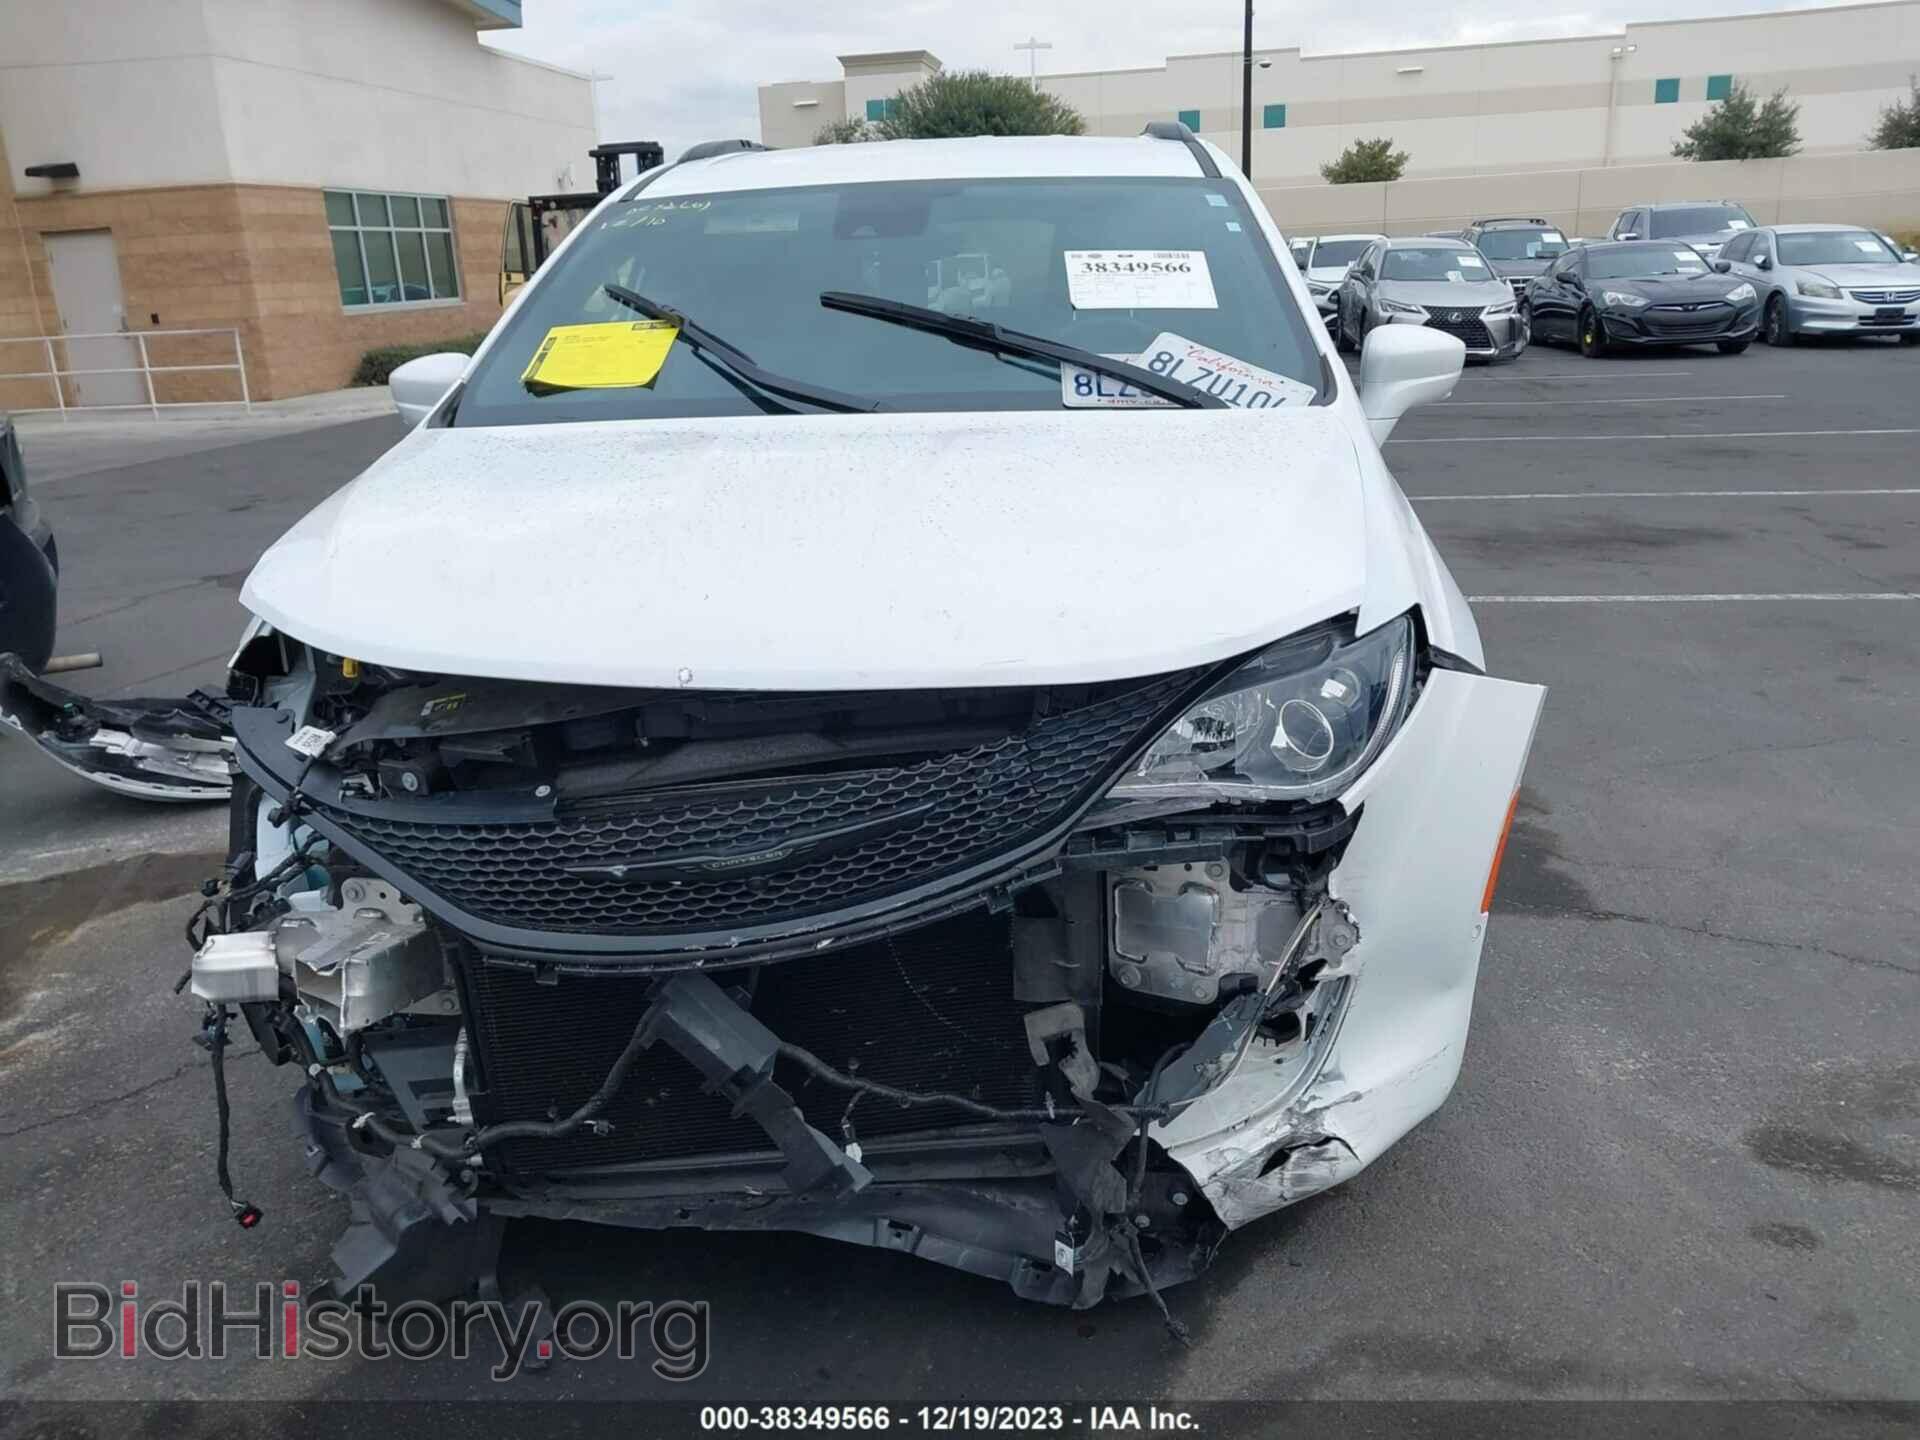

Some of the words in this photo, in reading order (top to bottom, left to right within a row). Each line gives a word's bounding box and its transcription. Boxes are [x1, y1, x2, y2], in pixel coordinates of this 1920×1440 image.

[1080, 262, 1191, 274] 38349566
[1187, 348, 1276, 390] California
[711, 850, 783, 868] CHRYSLER
